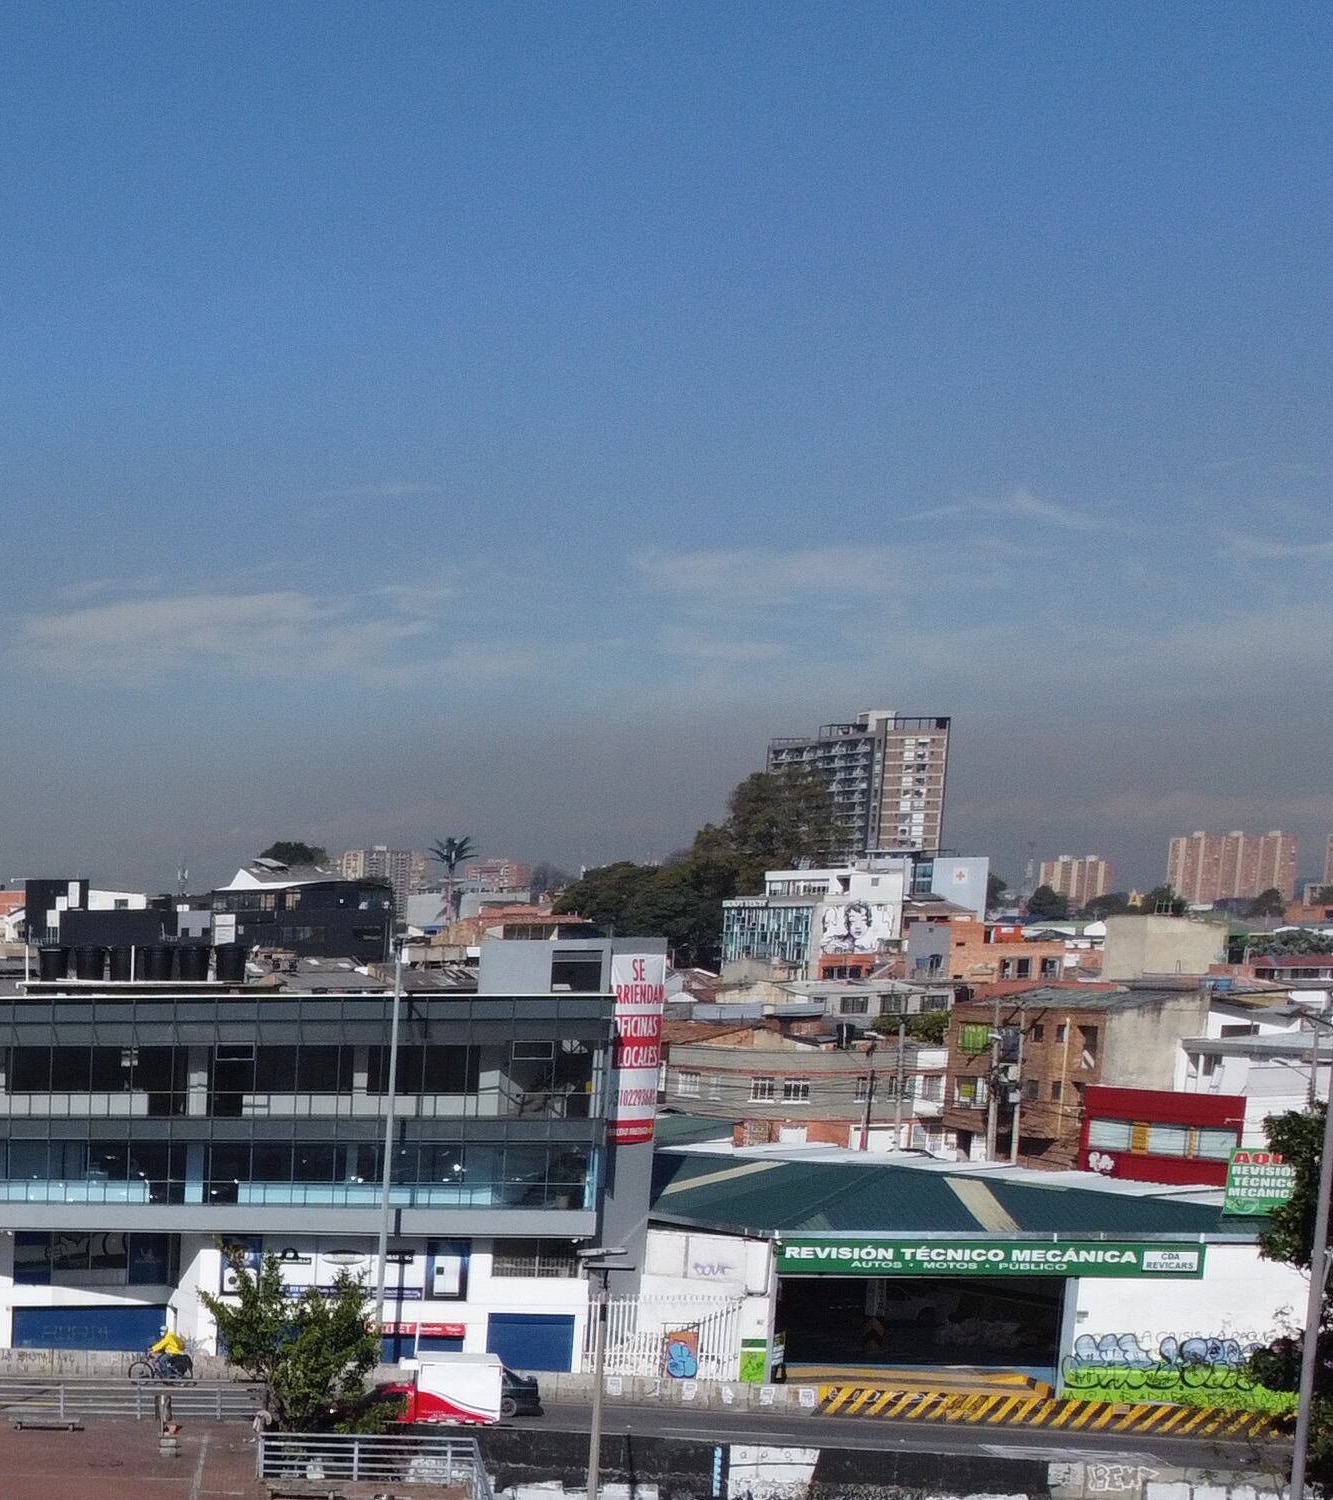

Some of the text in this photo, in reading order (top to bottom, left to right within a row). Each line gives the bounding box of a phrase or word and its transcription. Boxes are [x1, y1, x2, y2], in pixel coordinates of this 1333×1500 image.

[633, 959, 645, 981] SE
[617, 1047, 657, 1068] LOCALES
[786, 1245, 1137, 1264] REVISIÓN TÉCNICO MECÁNICA
[1161, 1252, 1180, 1261] CDA
[851, 1260, 1067, 1271] AUTOS MOTOS PÚBLICO
[1146, 1261, 1197, 1271] REVICARS
